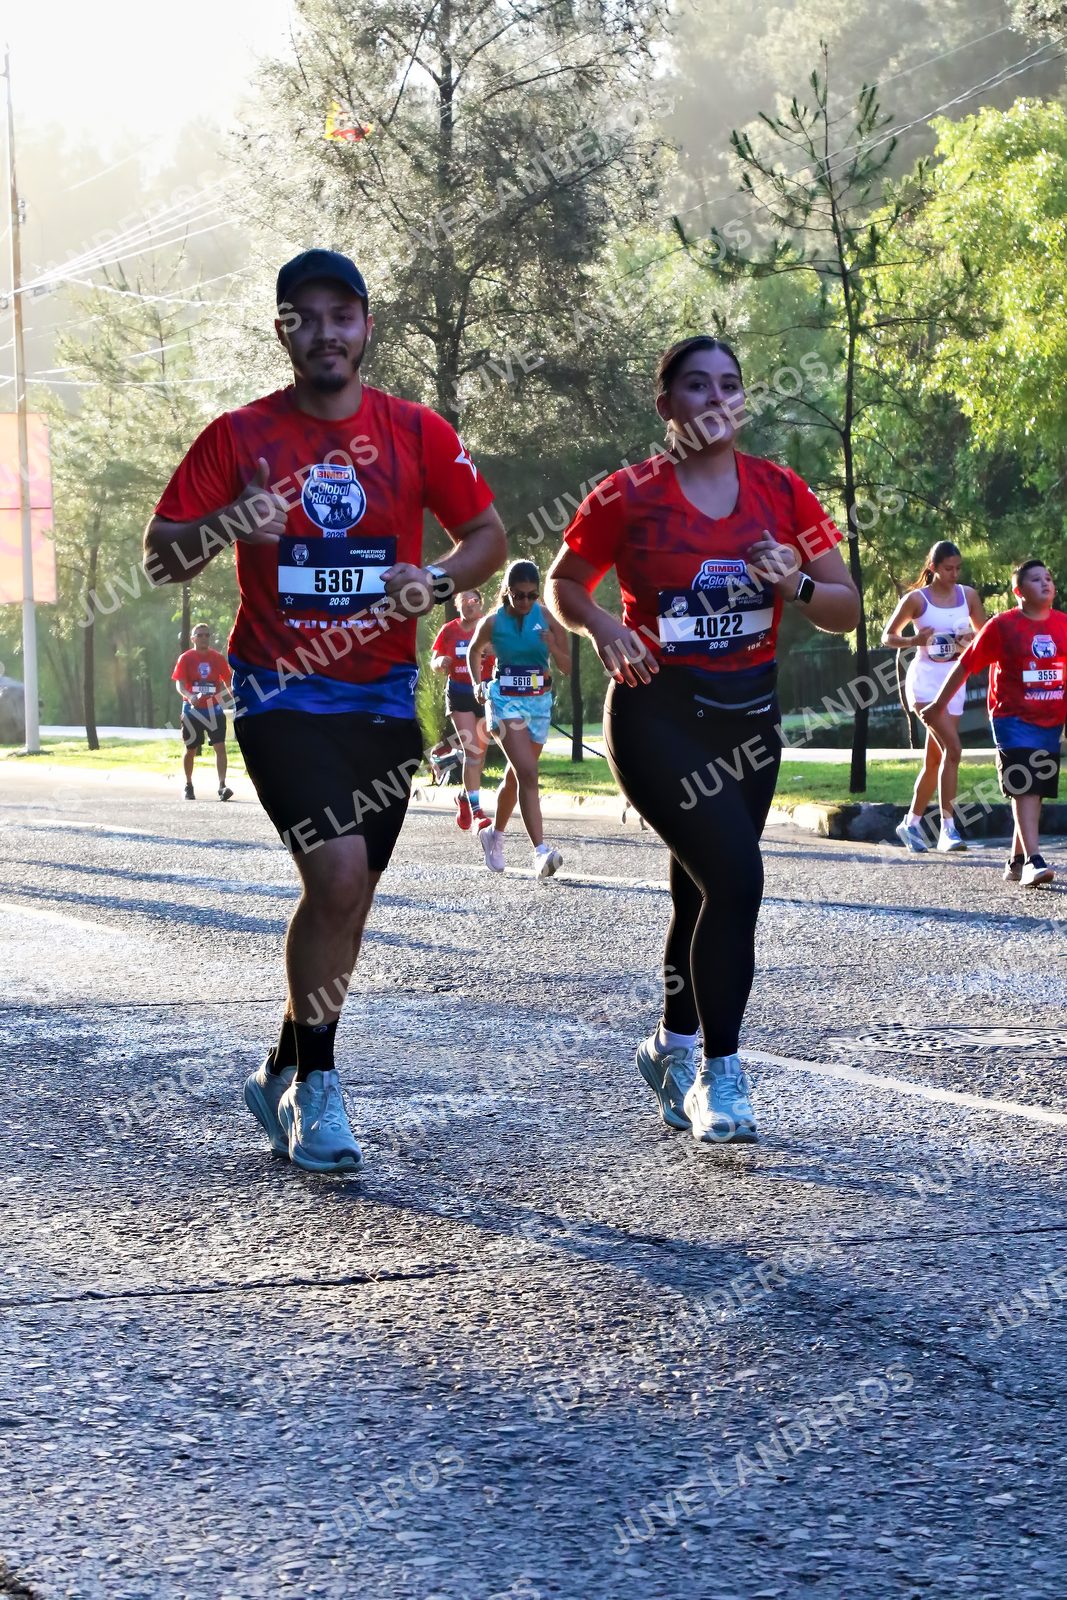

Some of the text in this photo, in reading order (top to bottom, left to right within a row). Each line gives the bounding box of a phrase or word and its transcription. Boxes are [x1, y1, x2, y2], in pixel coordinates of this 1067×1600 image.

[317, 470, 350, 480] BIMBO
[318, 482, 350, 495] Global
[312, 492, 338, 504] Race
[315, 569, 364, 593] 5367
[694, 613, 743, 639] 4022
[747, 642, 762, 652] 10K
[513, 676, 531, 686] 5618
[1038, 670, 1057, 681] 3555
